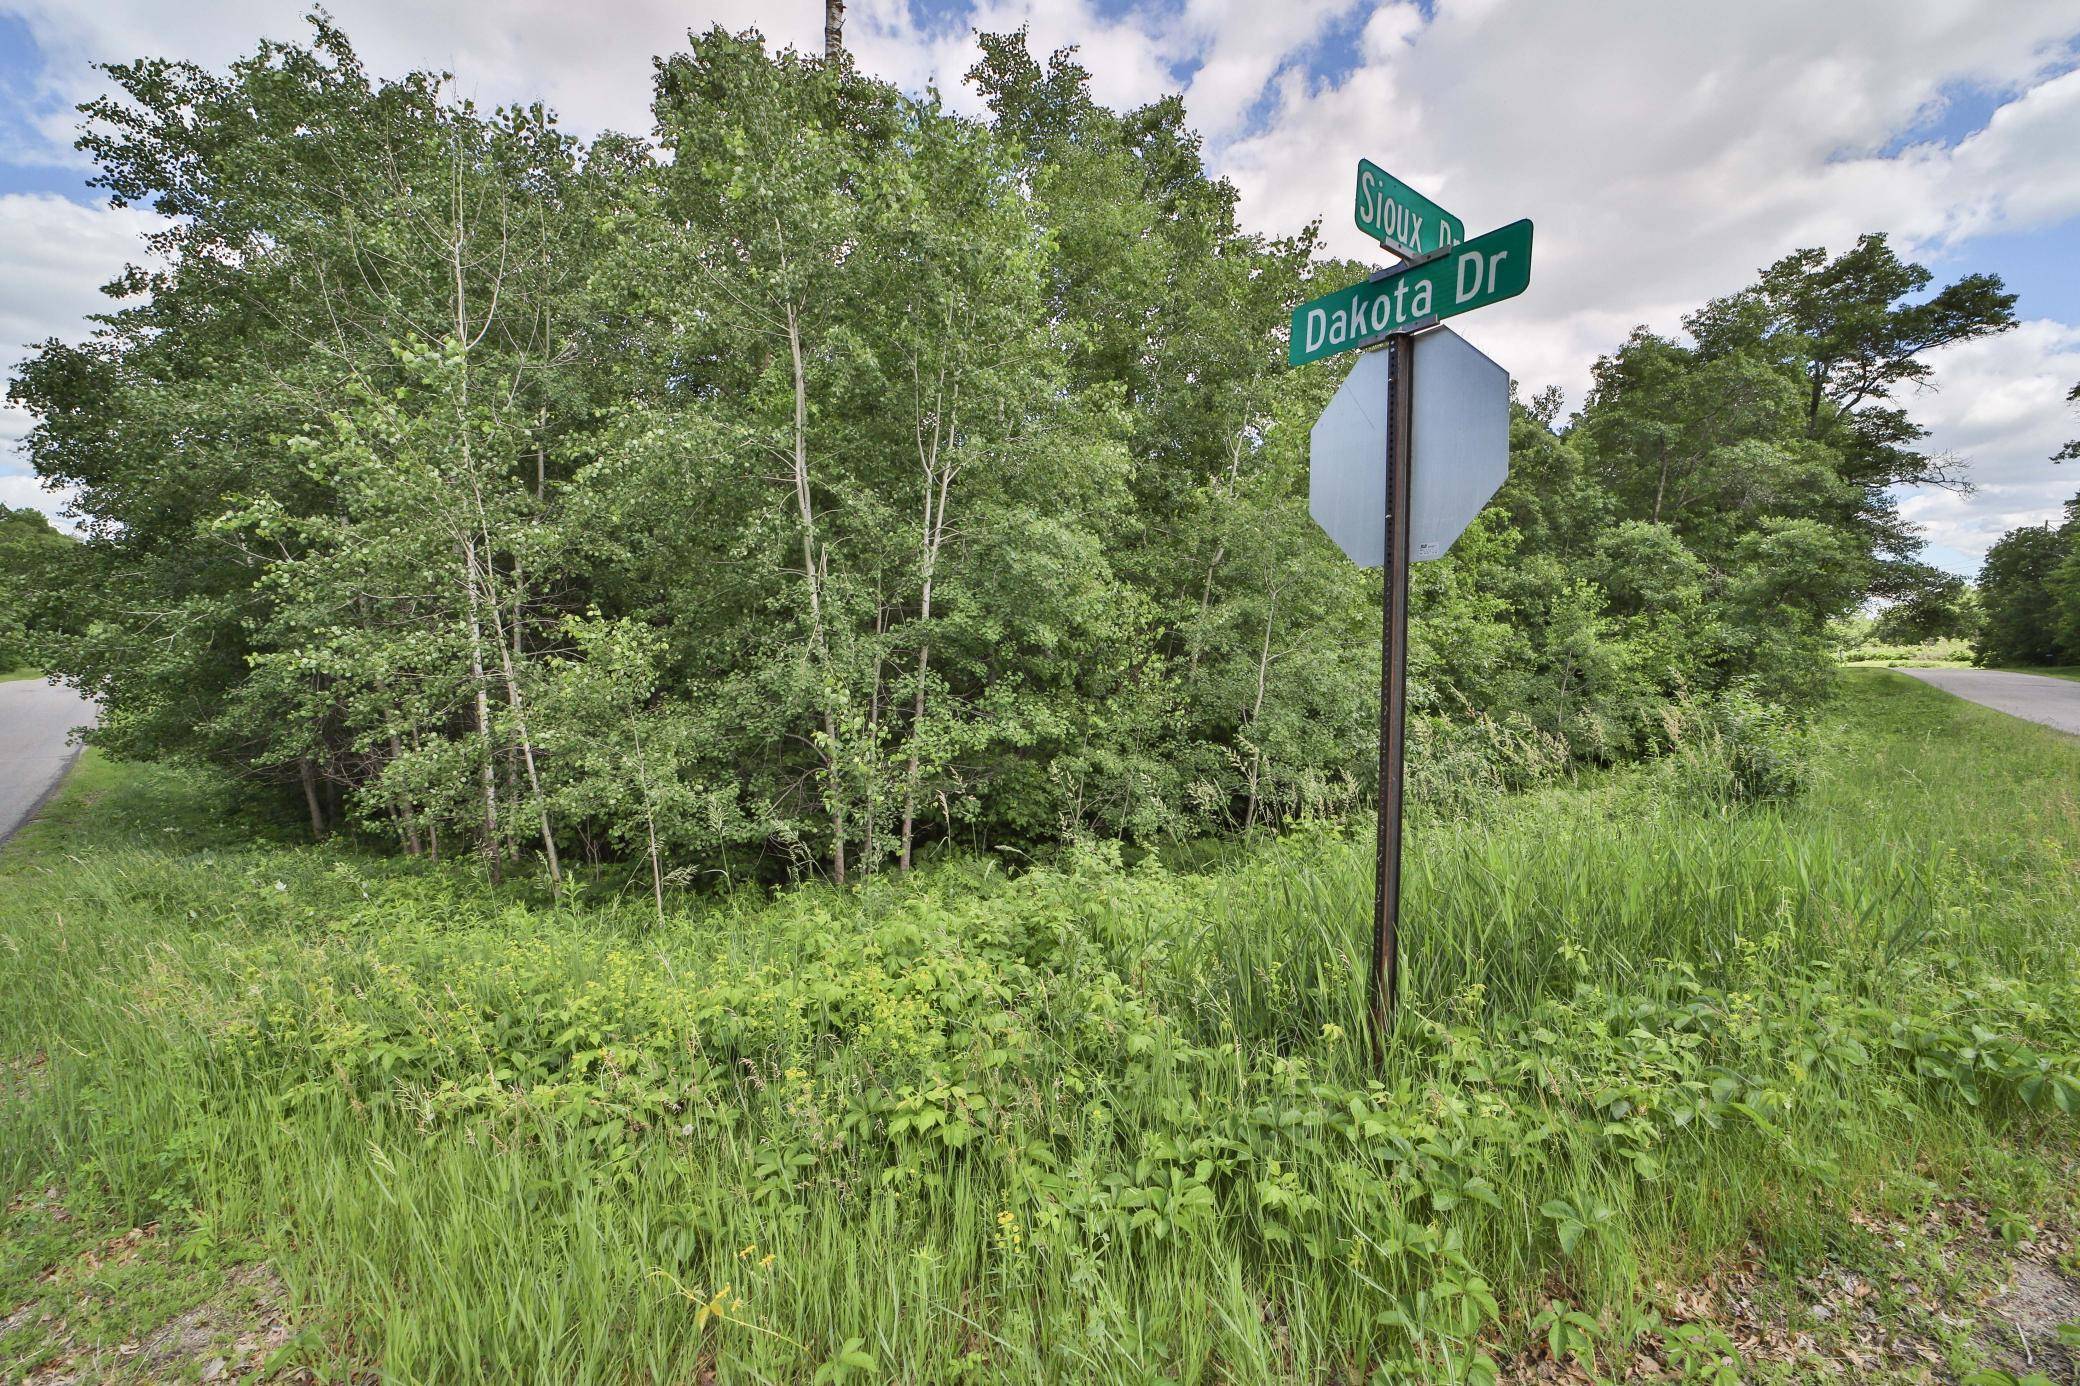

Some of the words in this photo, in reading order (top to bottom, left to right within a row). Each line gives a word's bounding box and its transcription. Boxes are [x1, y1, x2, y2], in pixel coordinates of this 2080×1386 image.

[1360, 171, 1423, 253] Sioux
[1305, 277, 1433, 353] Dakota
[1455, 250, 1508, 304] Dr
